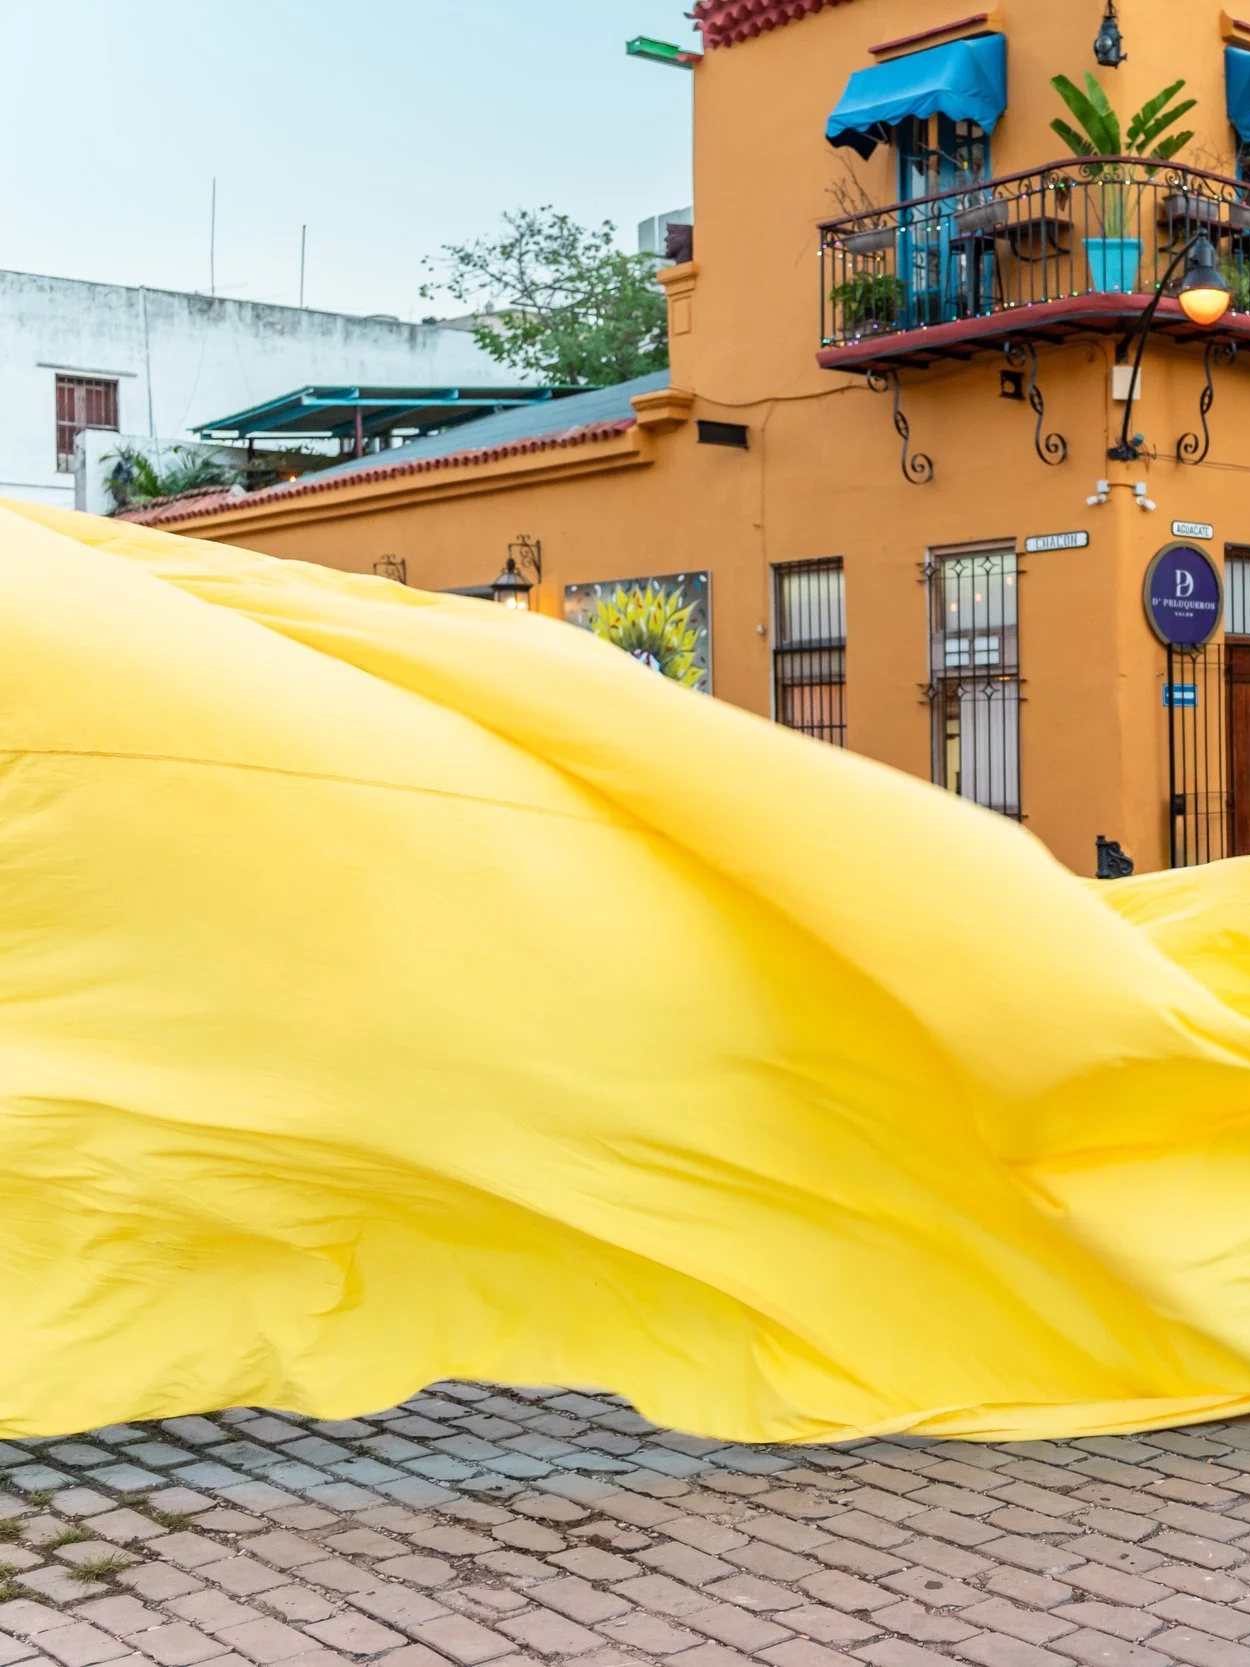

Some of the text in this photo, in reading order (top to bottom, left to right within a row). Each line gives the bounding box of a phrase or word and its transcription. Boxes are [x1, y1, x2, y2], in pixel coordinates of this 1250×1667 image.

[1177, 523, 1209, 537] AGUACATE
[1036, 534, 1077, 549] CHACON
[1163, 598, 1215, 610] PELUQUEROS
